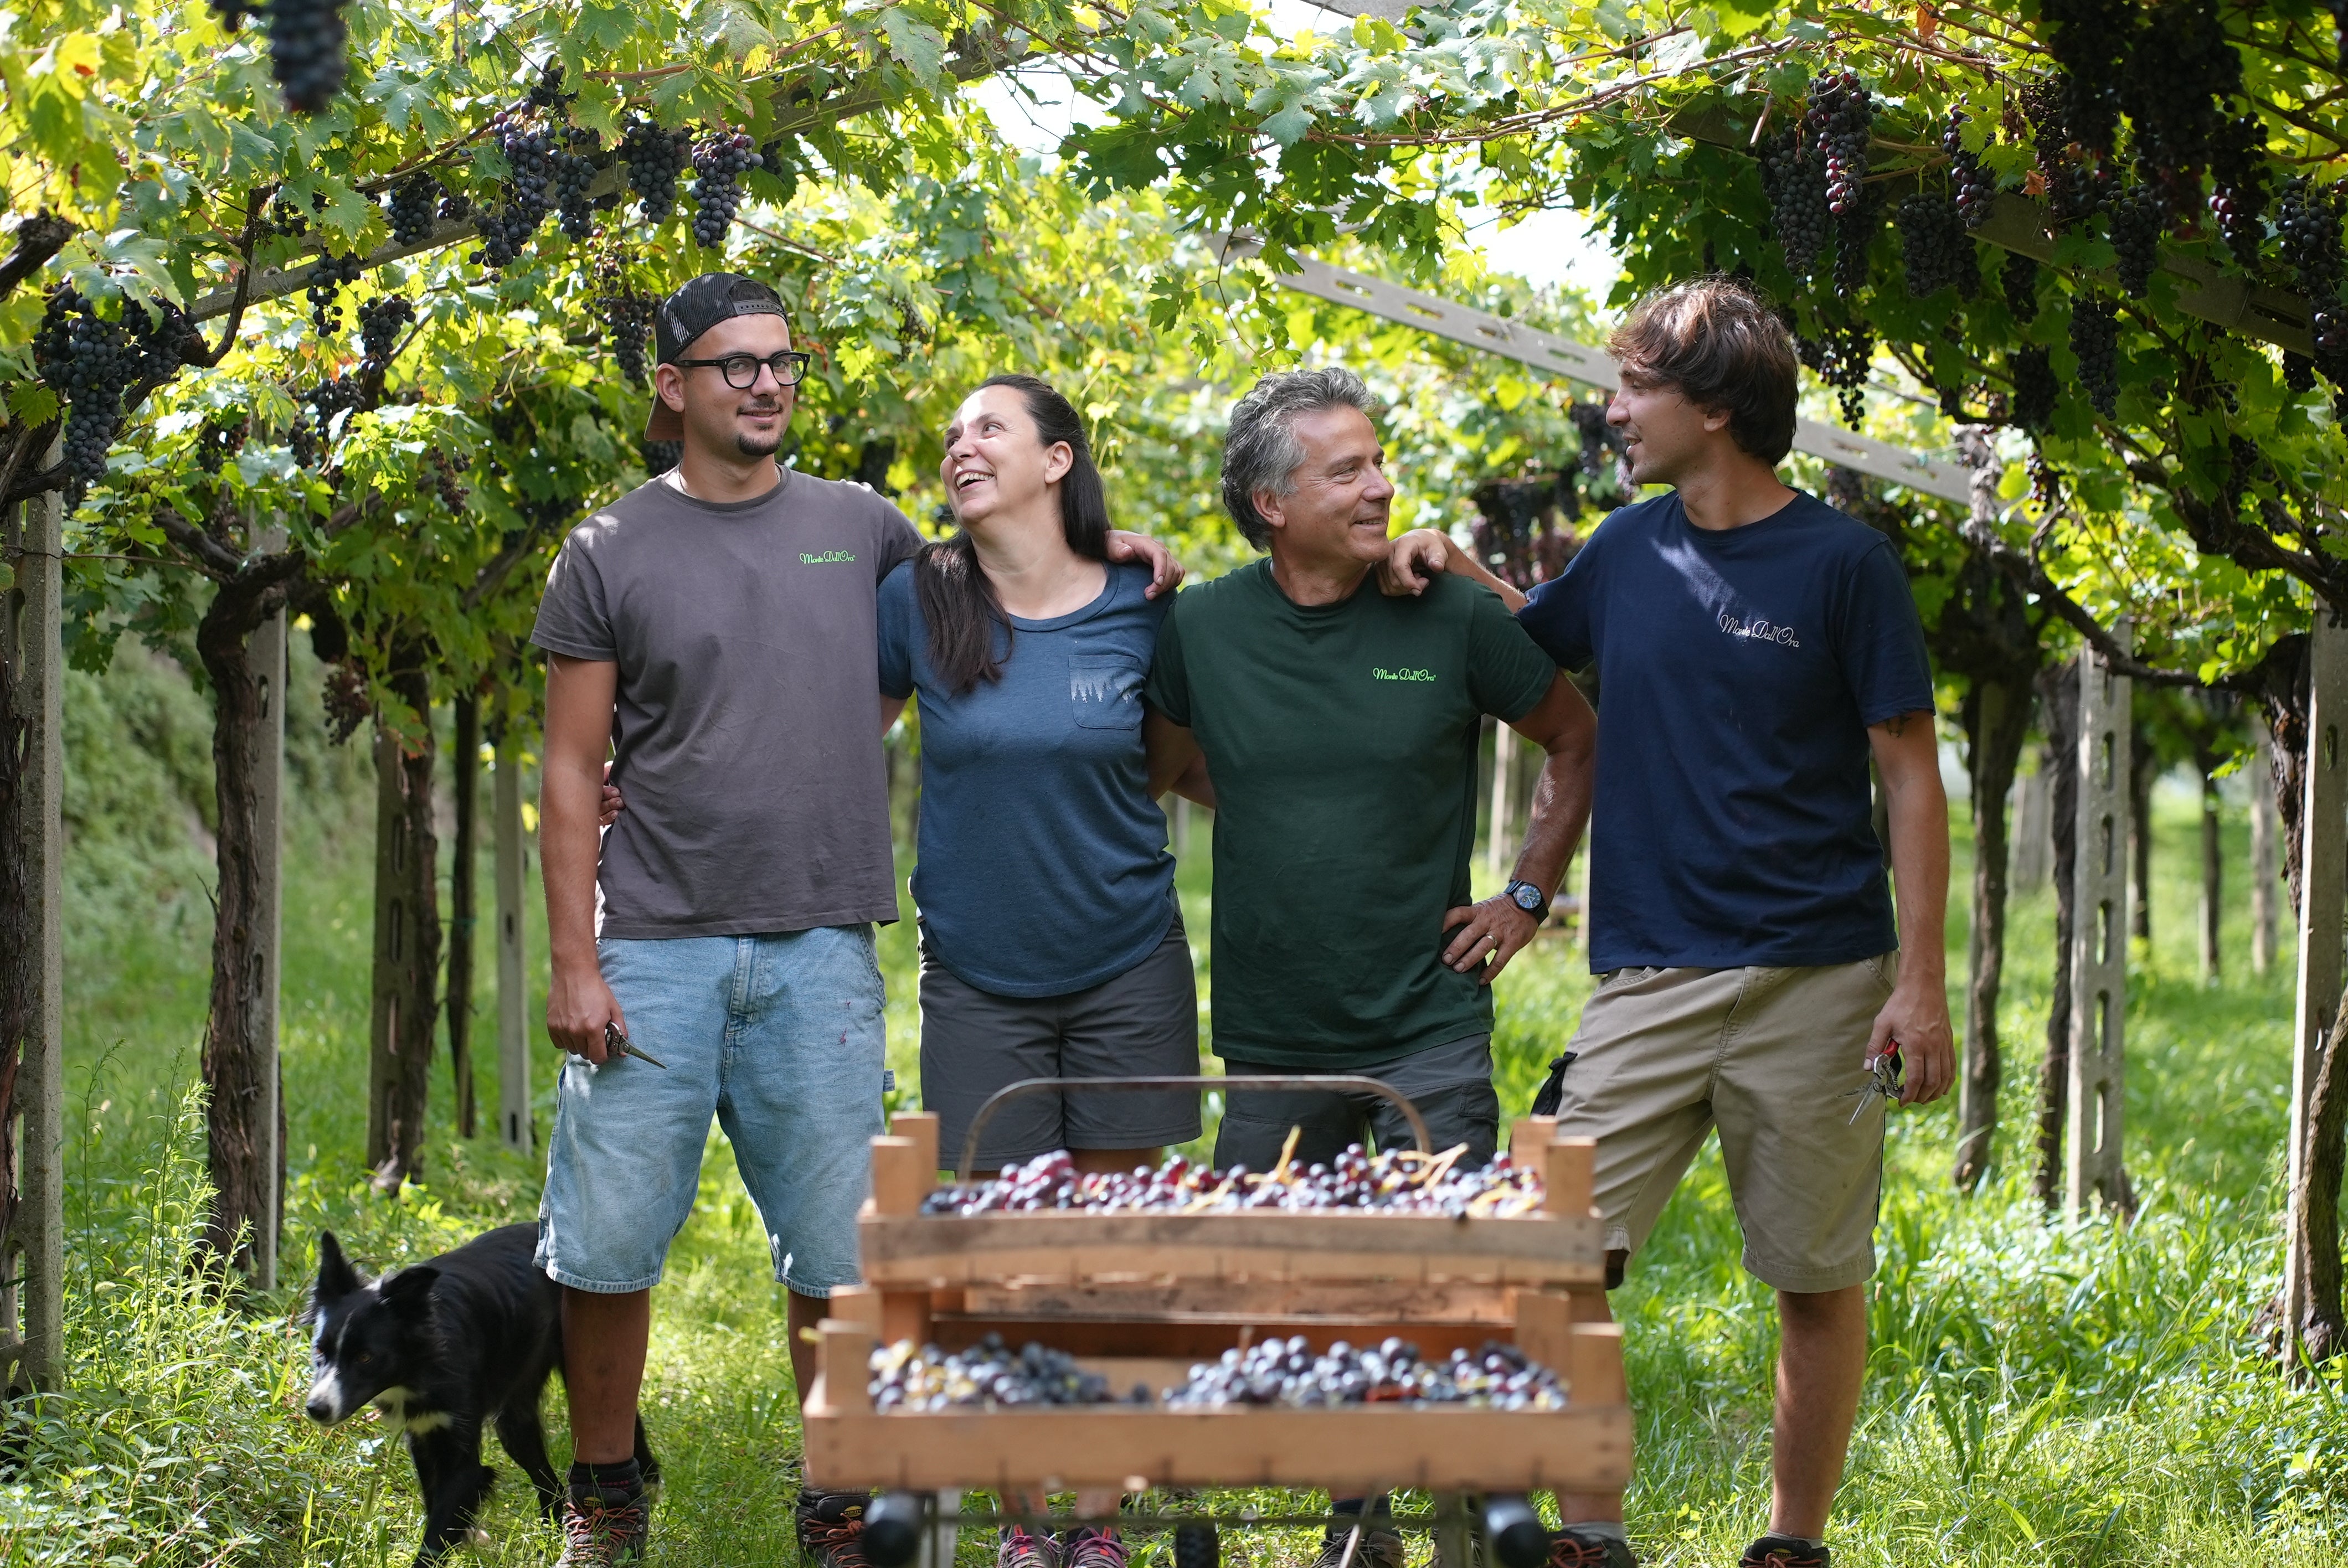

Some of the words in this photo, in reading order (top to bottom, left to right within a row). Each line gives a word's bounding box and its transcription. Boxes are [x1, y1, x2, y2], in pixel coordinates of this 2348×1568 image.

[799, 553, 823, 564] Monte
[1719, 614, 1751, 637] Monte
[1752, 620, 1800, 648] Dall'Ora
[1373, 667, 1398, 680] Monte
